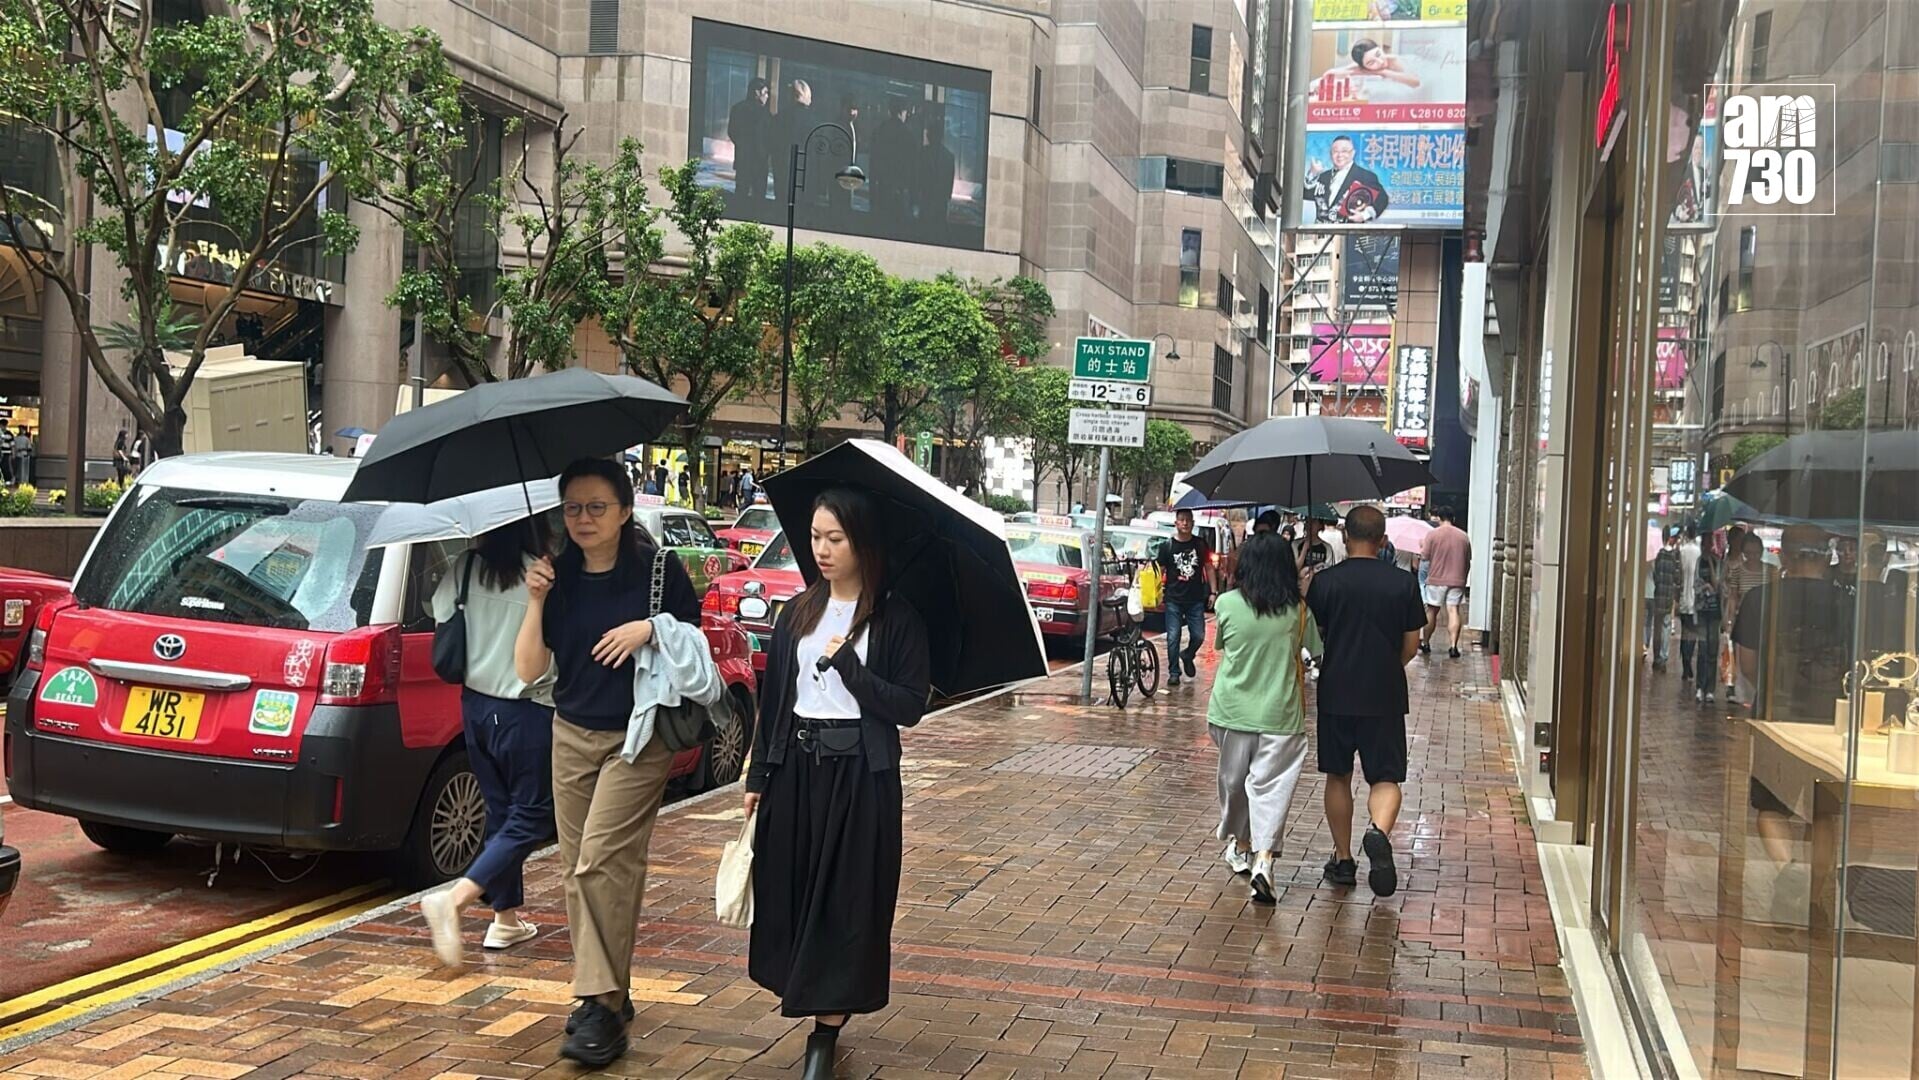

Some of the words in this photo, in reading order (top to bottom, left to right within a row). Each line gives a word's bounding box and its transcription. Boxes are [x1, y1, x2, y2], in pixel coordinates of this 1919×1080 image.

[1312, 107, 1352, 117] GLYCEL
[1375, 109, 1398, 119] 11/F
[1418, 108, 1444, 119] 2810
[1082, 344, 1105, 355] TAXI
[1108, 345, 1145, 357] STAND
[1087, 357, 1136, 375] 的士站
[1090, 384, 1107, 399] 12
[1136, 387, 1146, 401] 6
[61, 671, 90, 685] TAXI
[66, 683, 76, 695] 4
[55, 692, 83, 703] SEATS
[149, 689, 182, 714] WR
[135, 711, 186, 738] 4131
